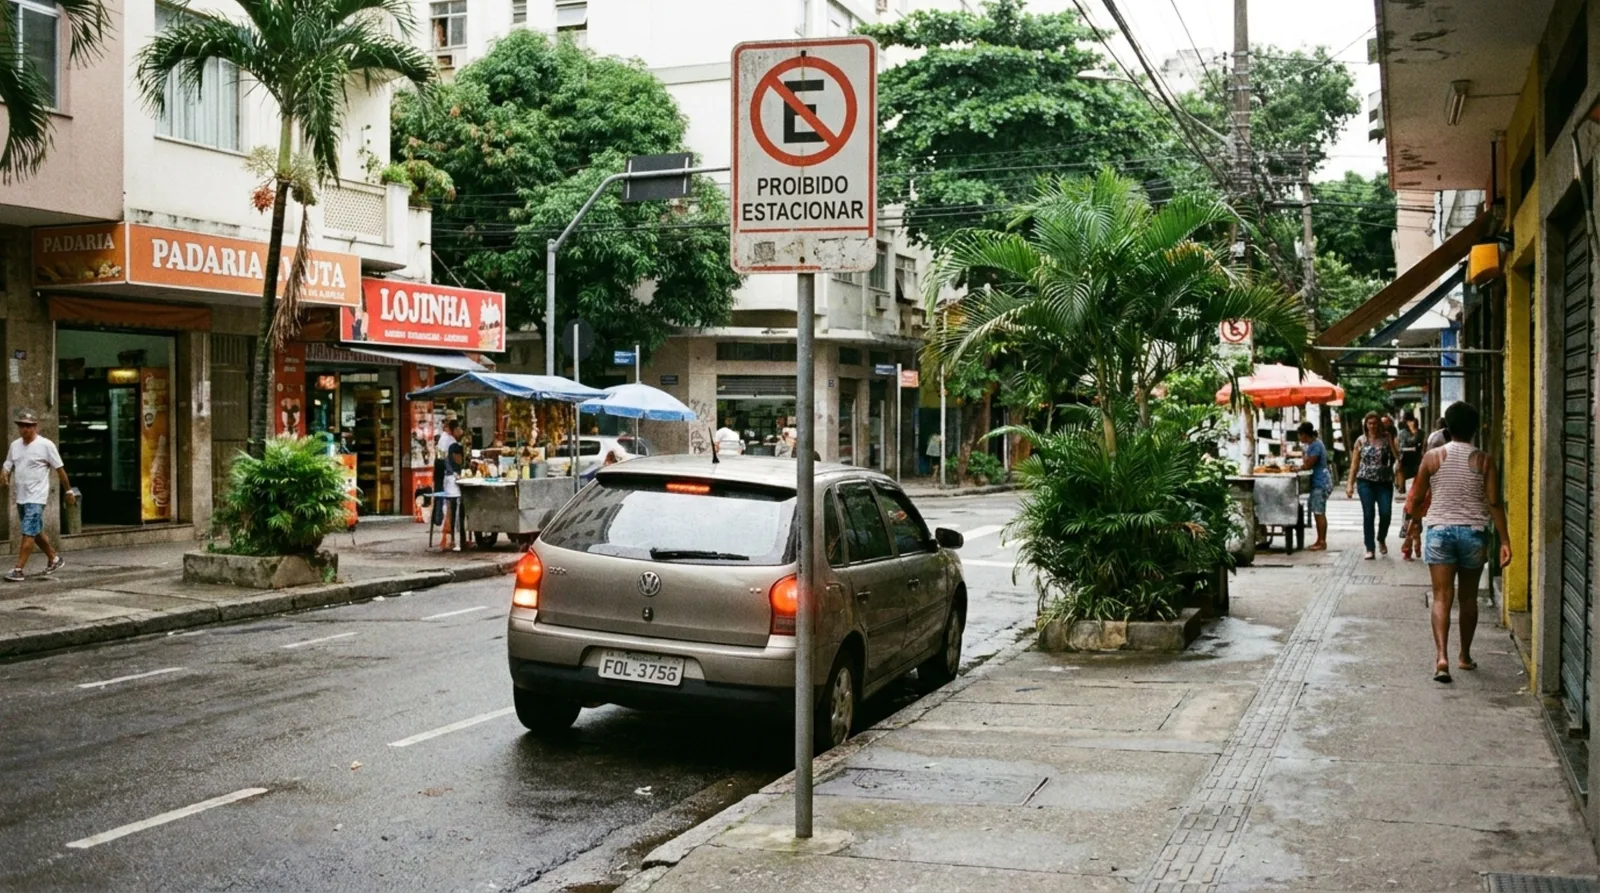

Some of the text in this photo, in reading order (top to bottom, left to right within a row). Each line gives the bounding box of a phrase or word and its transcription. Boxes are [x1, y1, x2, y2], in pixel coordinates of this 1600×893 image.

[757, 175, 848, 196] PROIBIDO
[742, 200, 864, 221] ESTACIONAR
[43, 232, 115, 253] PADARIA
[152, 238, 264, 280] PADARIA
[380, 287, 472, 329] LOJINHA
